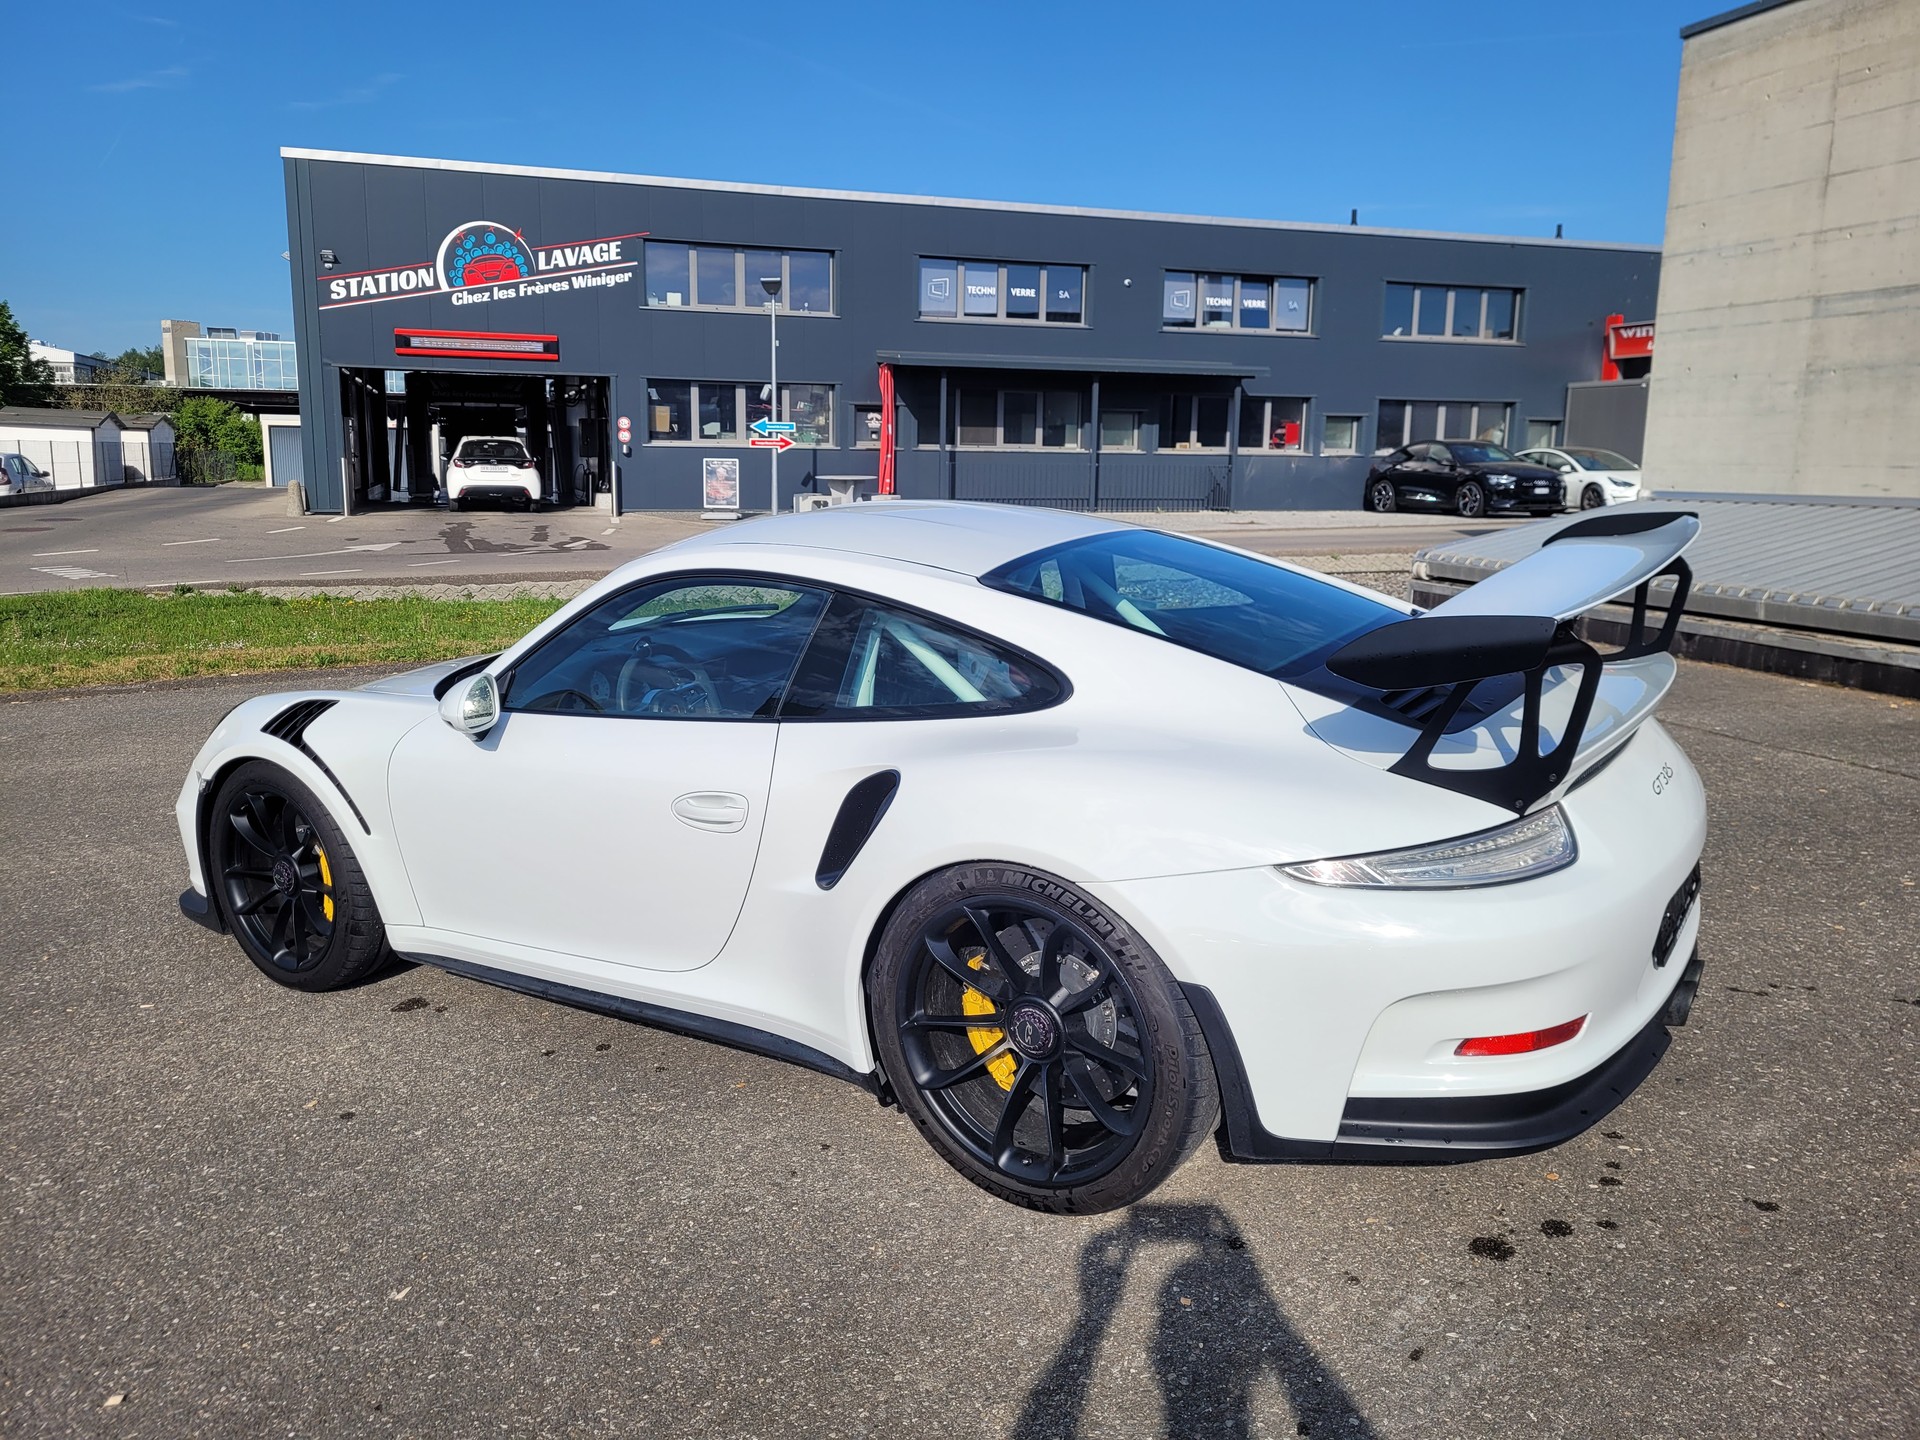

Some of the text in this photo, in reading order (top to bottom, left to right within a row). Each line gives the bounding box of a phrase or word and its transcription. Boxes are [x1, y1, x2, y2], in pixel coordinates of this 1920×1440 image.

[330, 240, 622, 300] STATION LAVAGE
[451, 270, 633, 307] Chez les Frères Winiger
[966, 285, 1070, 299] TECHNI VERRE SA
[1205, 297, 1232, 307] TECHNI
[1242, 299, 1267, 309] VERRE
[1000, 870, 1114, 934] MICHELIN
